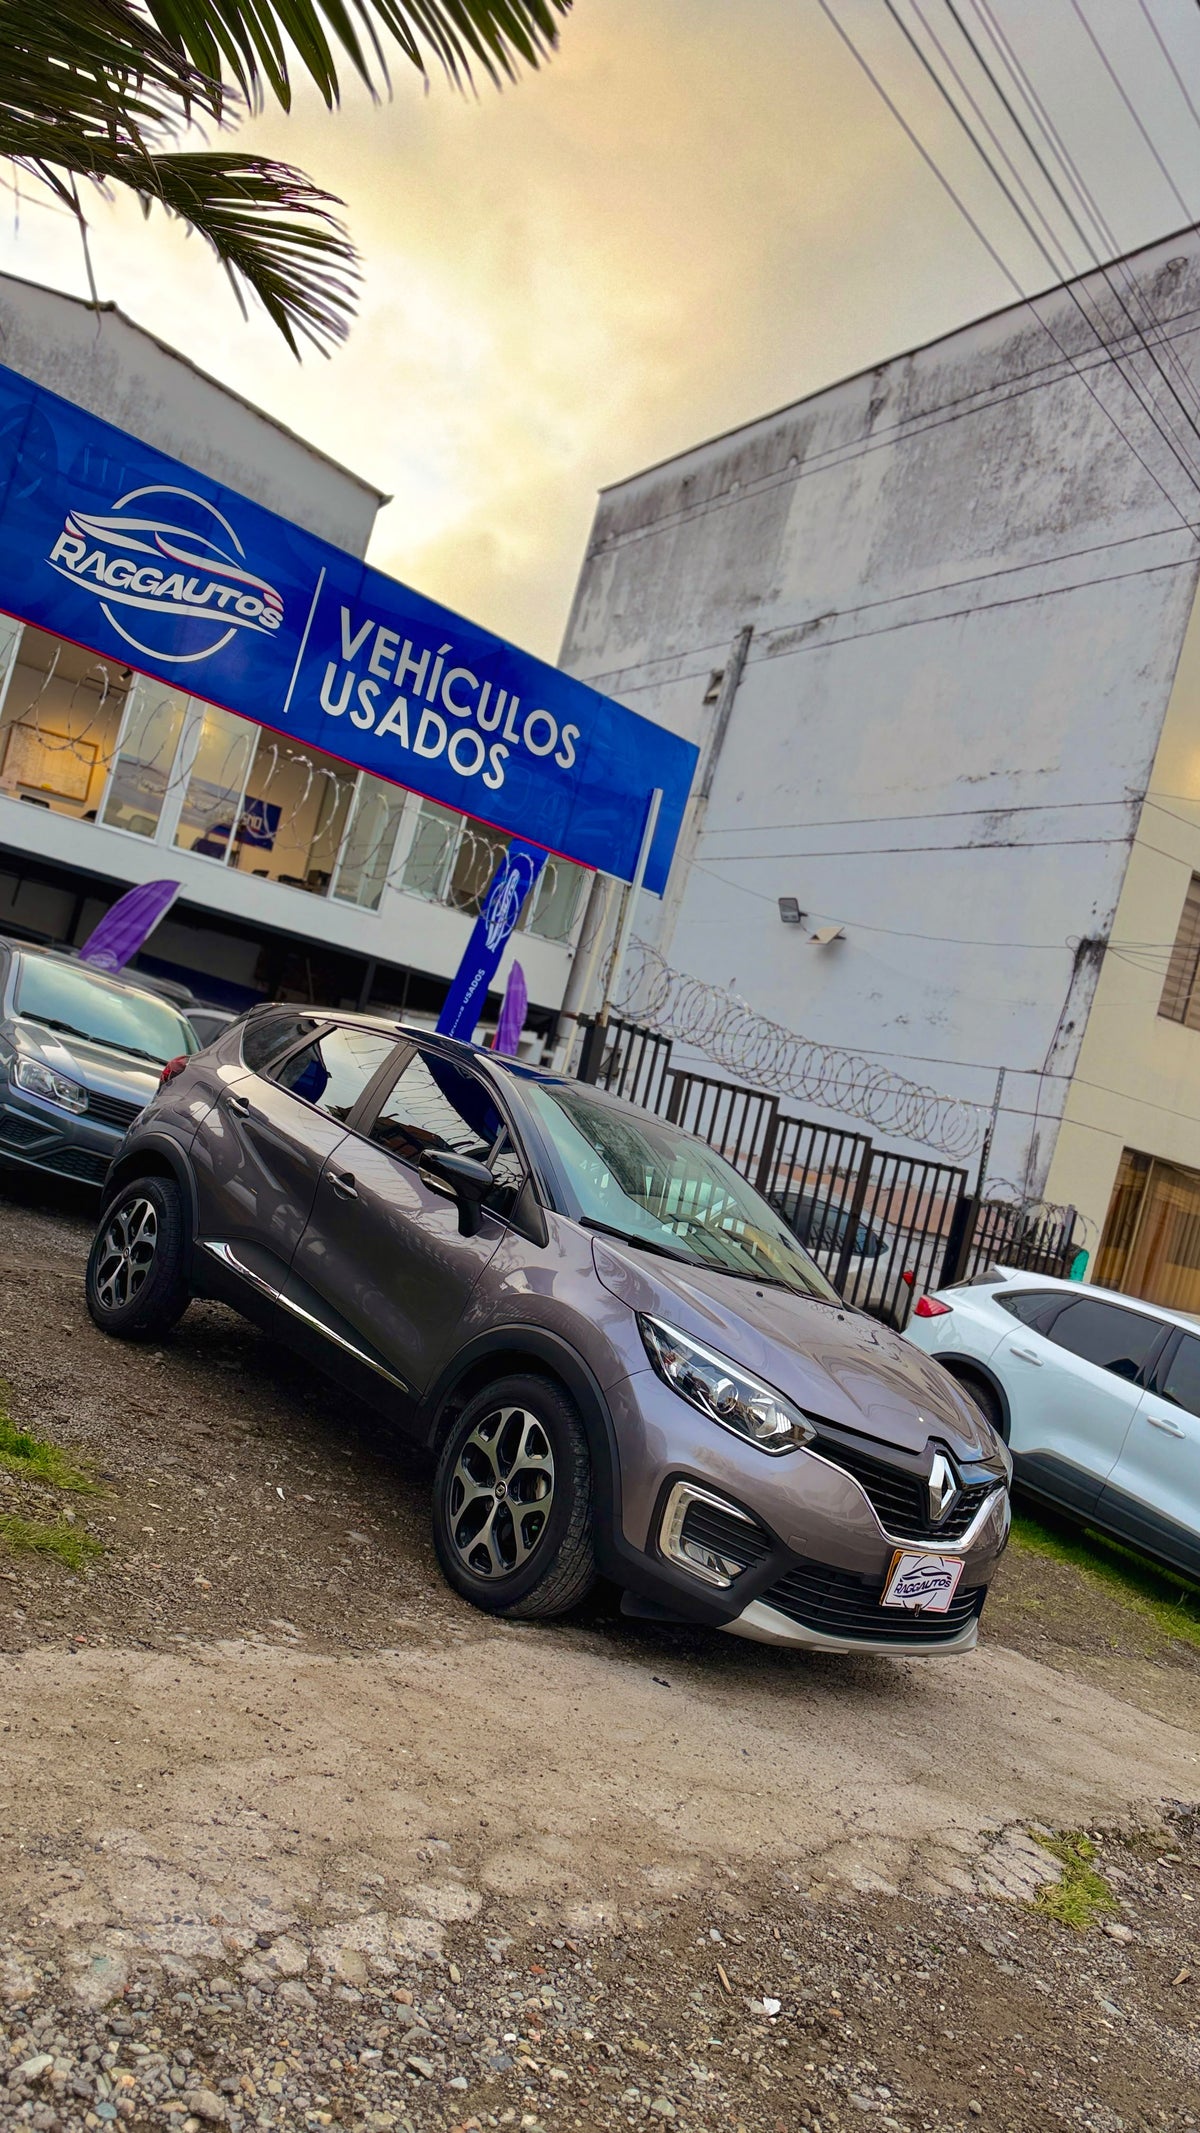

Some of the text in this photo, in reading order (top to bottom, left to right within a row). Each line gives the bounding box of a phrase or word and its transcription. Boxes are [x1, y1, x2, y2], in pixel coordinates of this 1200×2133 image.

[50, 531, 284, 630] RAGGAUTOS
[319, 661, 510, 790] USADOS
[340, 605, 581, 769] VEHÍCULOS
[463, 968, 486, 1004] USADOS
[894, 1579, 952, 1594] RAGGAUTOS
